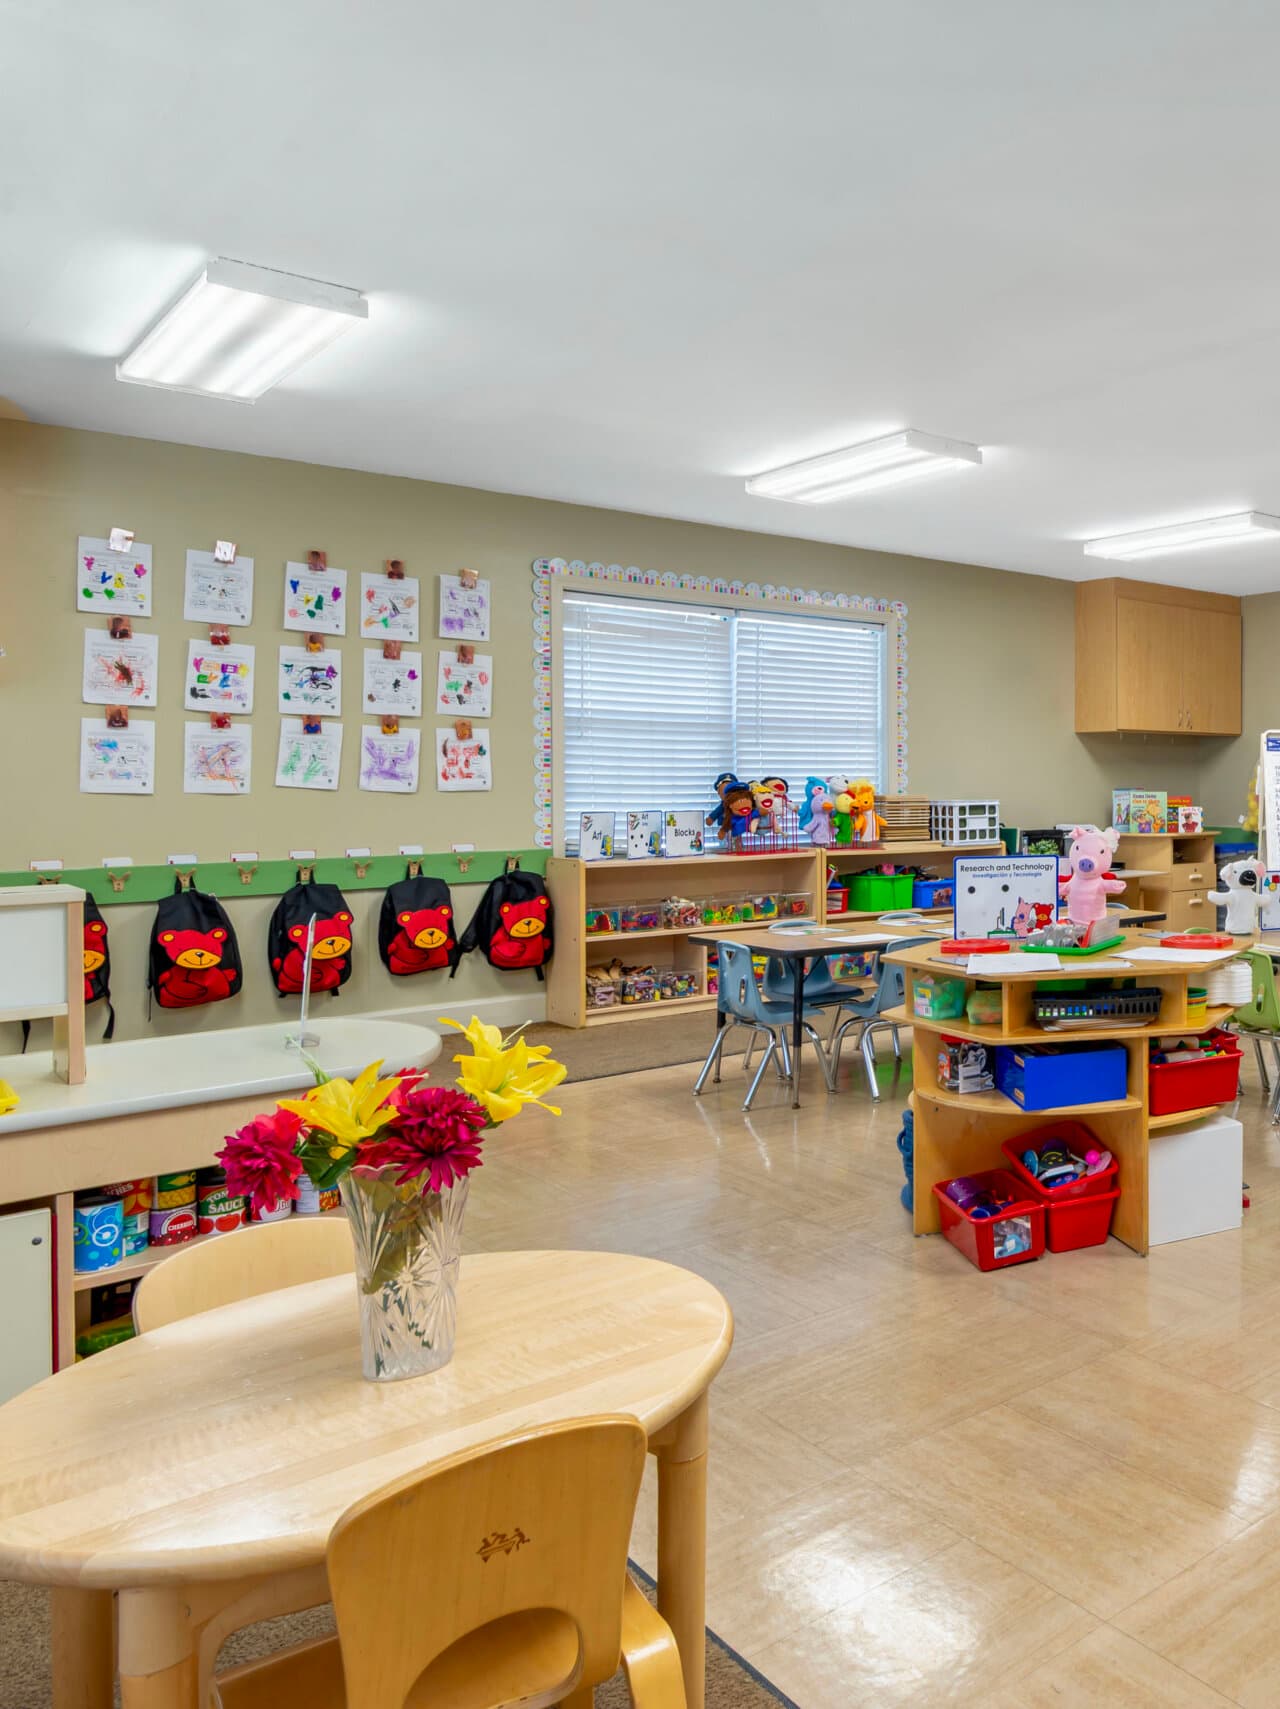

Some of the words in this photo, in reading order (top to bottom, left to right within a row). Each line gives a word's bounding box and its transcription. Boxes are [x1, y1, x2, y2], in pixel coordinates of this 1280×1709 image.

[592, 830, 602, 841] Art
[674, 828, 695, 837] Blocks
[960, 864, 994, 873] Research
[1012, 863, 1054, 873] Technology
[208, 1197, 245, 1214] SAUCE
